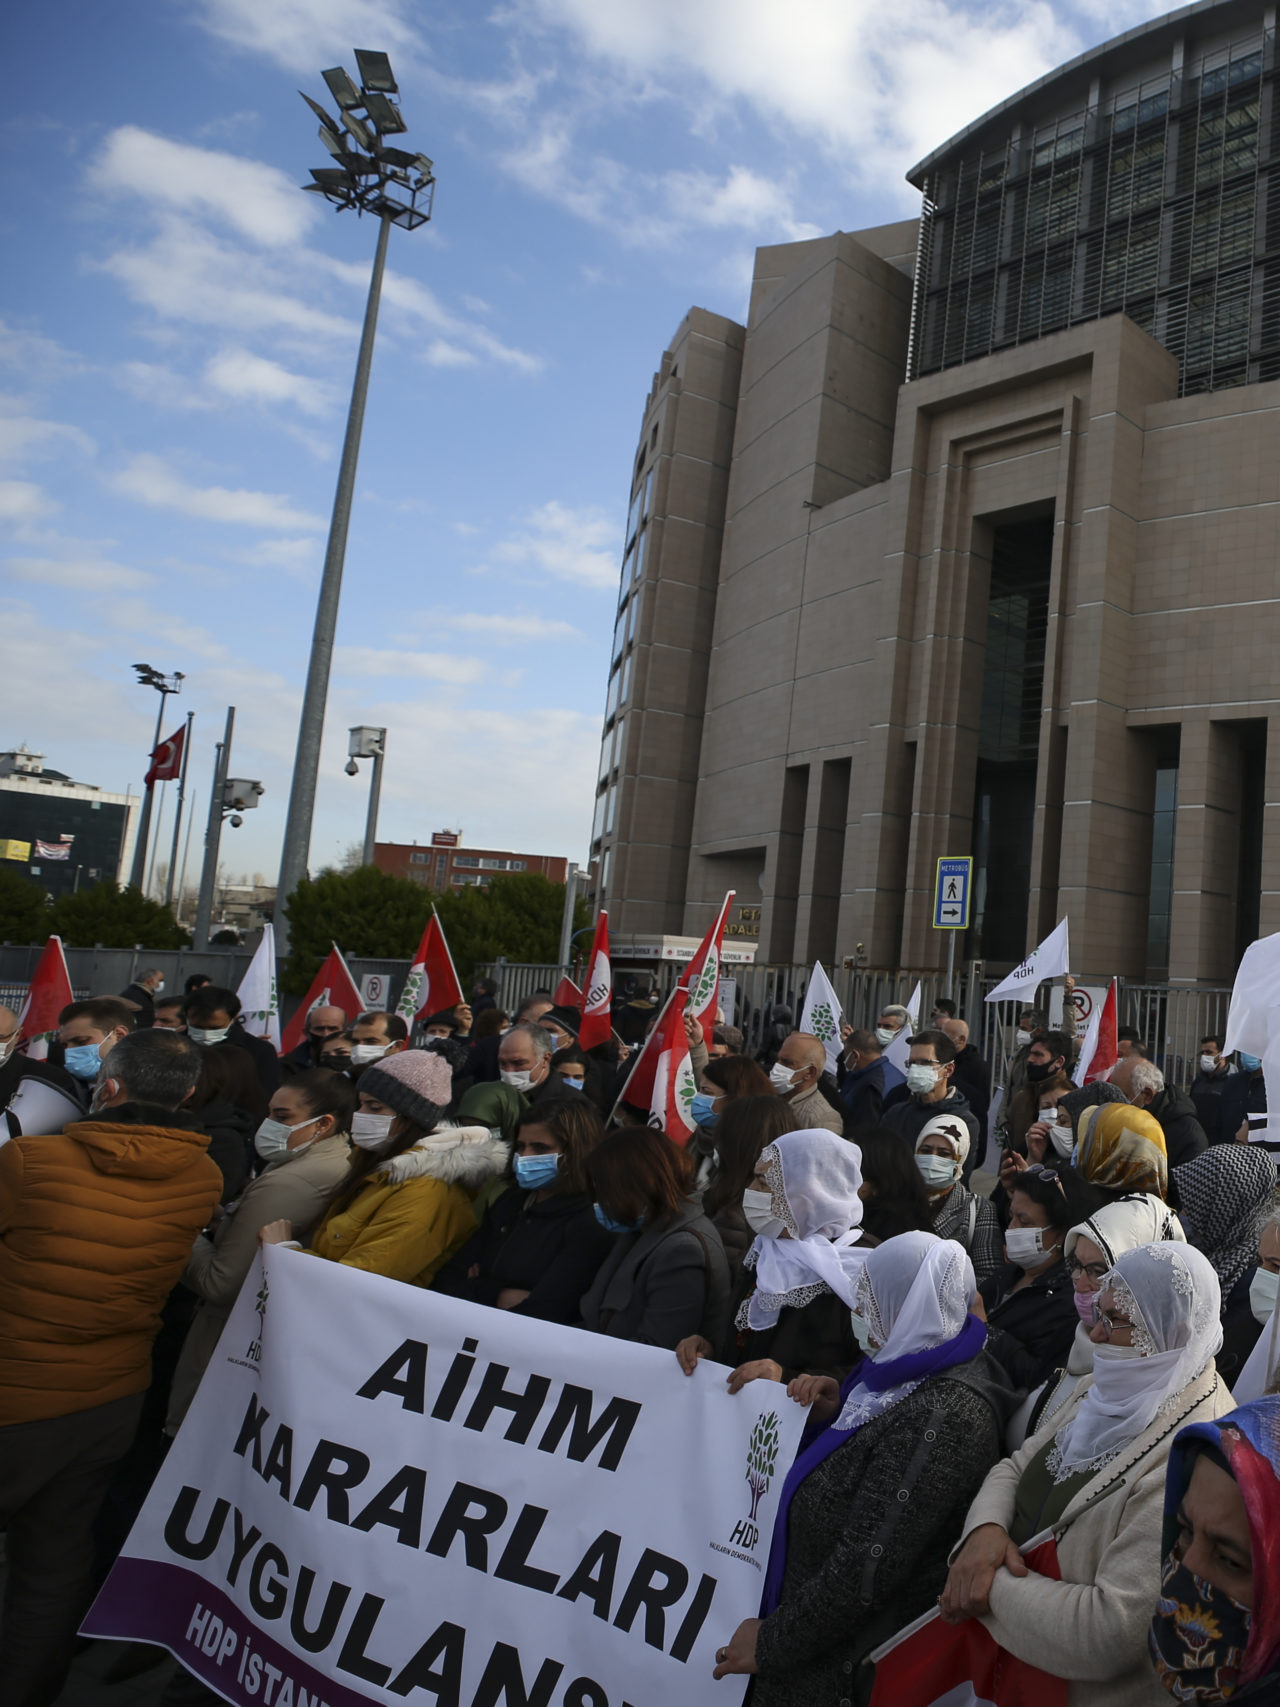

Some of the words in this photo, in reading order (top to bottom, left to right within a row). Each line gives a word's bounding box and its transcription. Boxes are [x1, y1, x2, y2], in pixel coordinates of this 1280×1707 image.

[723, 924, 760, 936] ADALE
[246, 1340, 262, 1362] HD
[356, 1337, 642, 1472] AİHM
[233, 1392, 718, 1664] KARARLARI
[729, 1519, 759, 1551] HDP
[163, 1485, 635, 1707] UYGULAN
[185, 1603, 237, 1666] HDP
